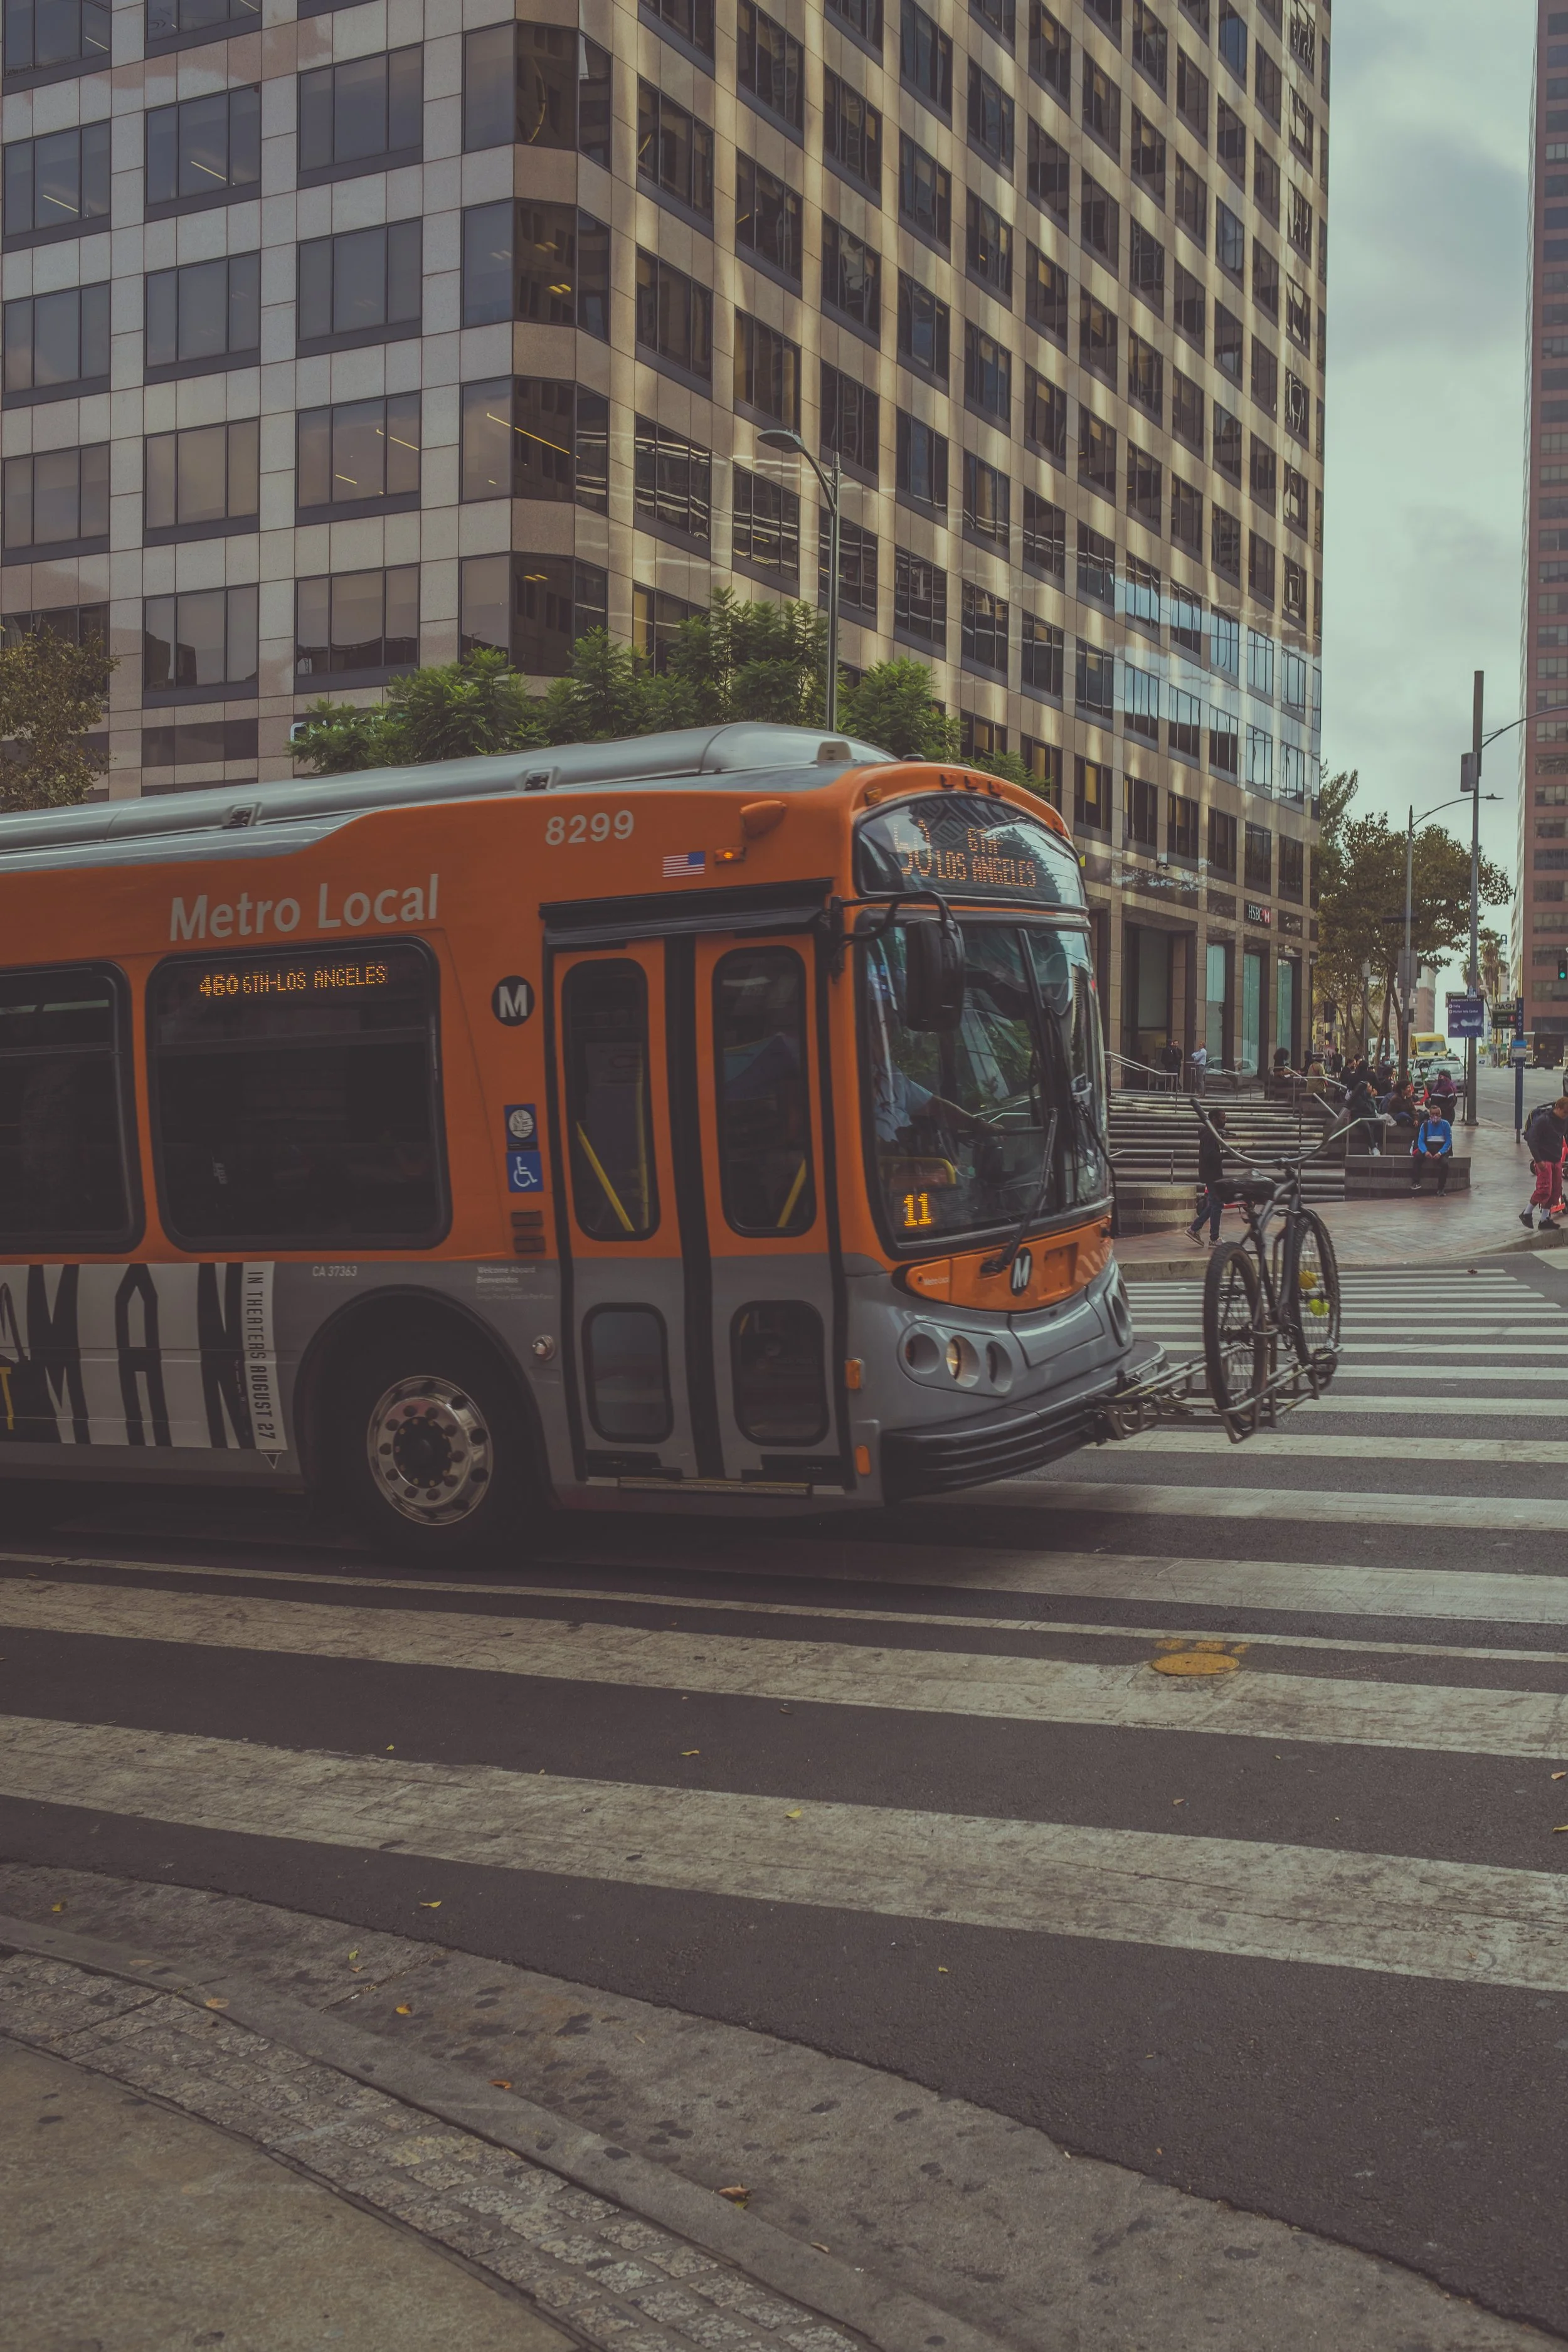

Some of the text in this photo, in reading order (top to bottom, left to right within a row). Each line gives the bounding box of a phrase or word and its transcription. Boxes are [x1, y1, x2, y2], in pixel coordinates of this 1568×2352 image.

[545, 810, 635, 845] 8299
[936, 849, 1036, 887] LOS ANGELES
[170, 873, 439, 941] Metro Local
[1248, 904, 1263, 922] HSBC
[199, 965, 388, 997] 460 6TH-LOS ANGELES
[499, 984, 528, 1018] M
[903, 1192, 932, 1227] 11
[312, 1265, 358, 1277] CA 37363
[510, 1266, 536, 1274] Aboard
[1012, 1255, 1031, 1290] M
[246, 1271, 276, 1440] IN THEATERS AUGUST 27
